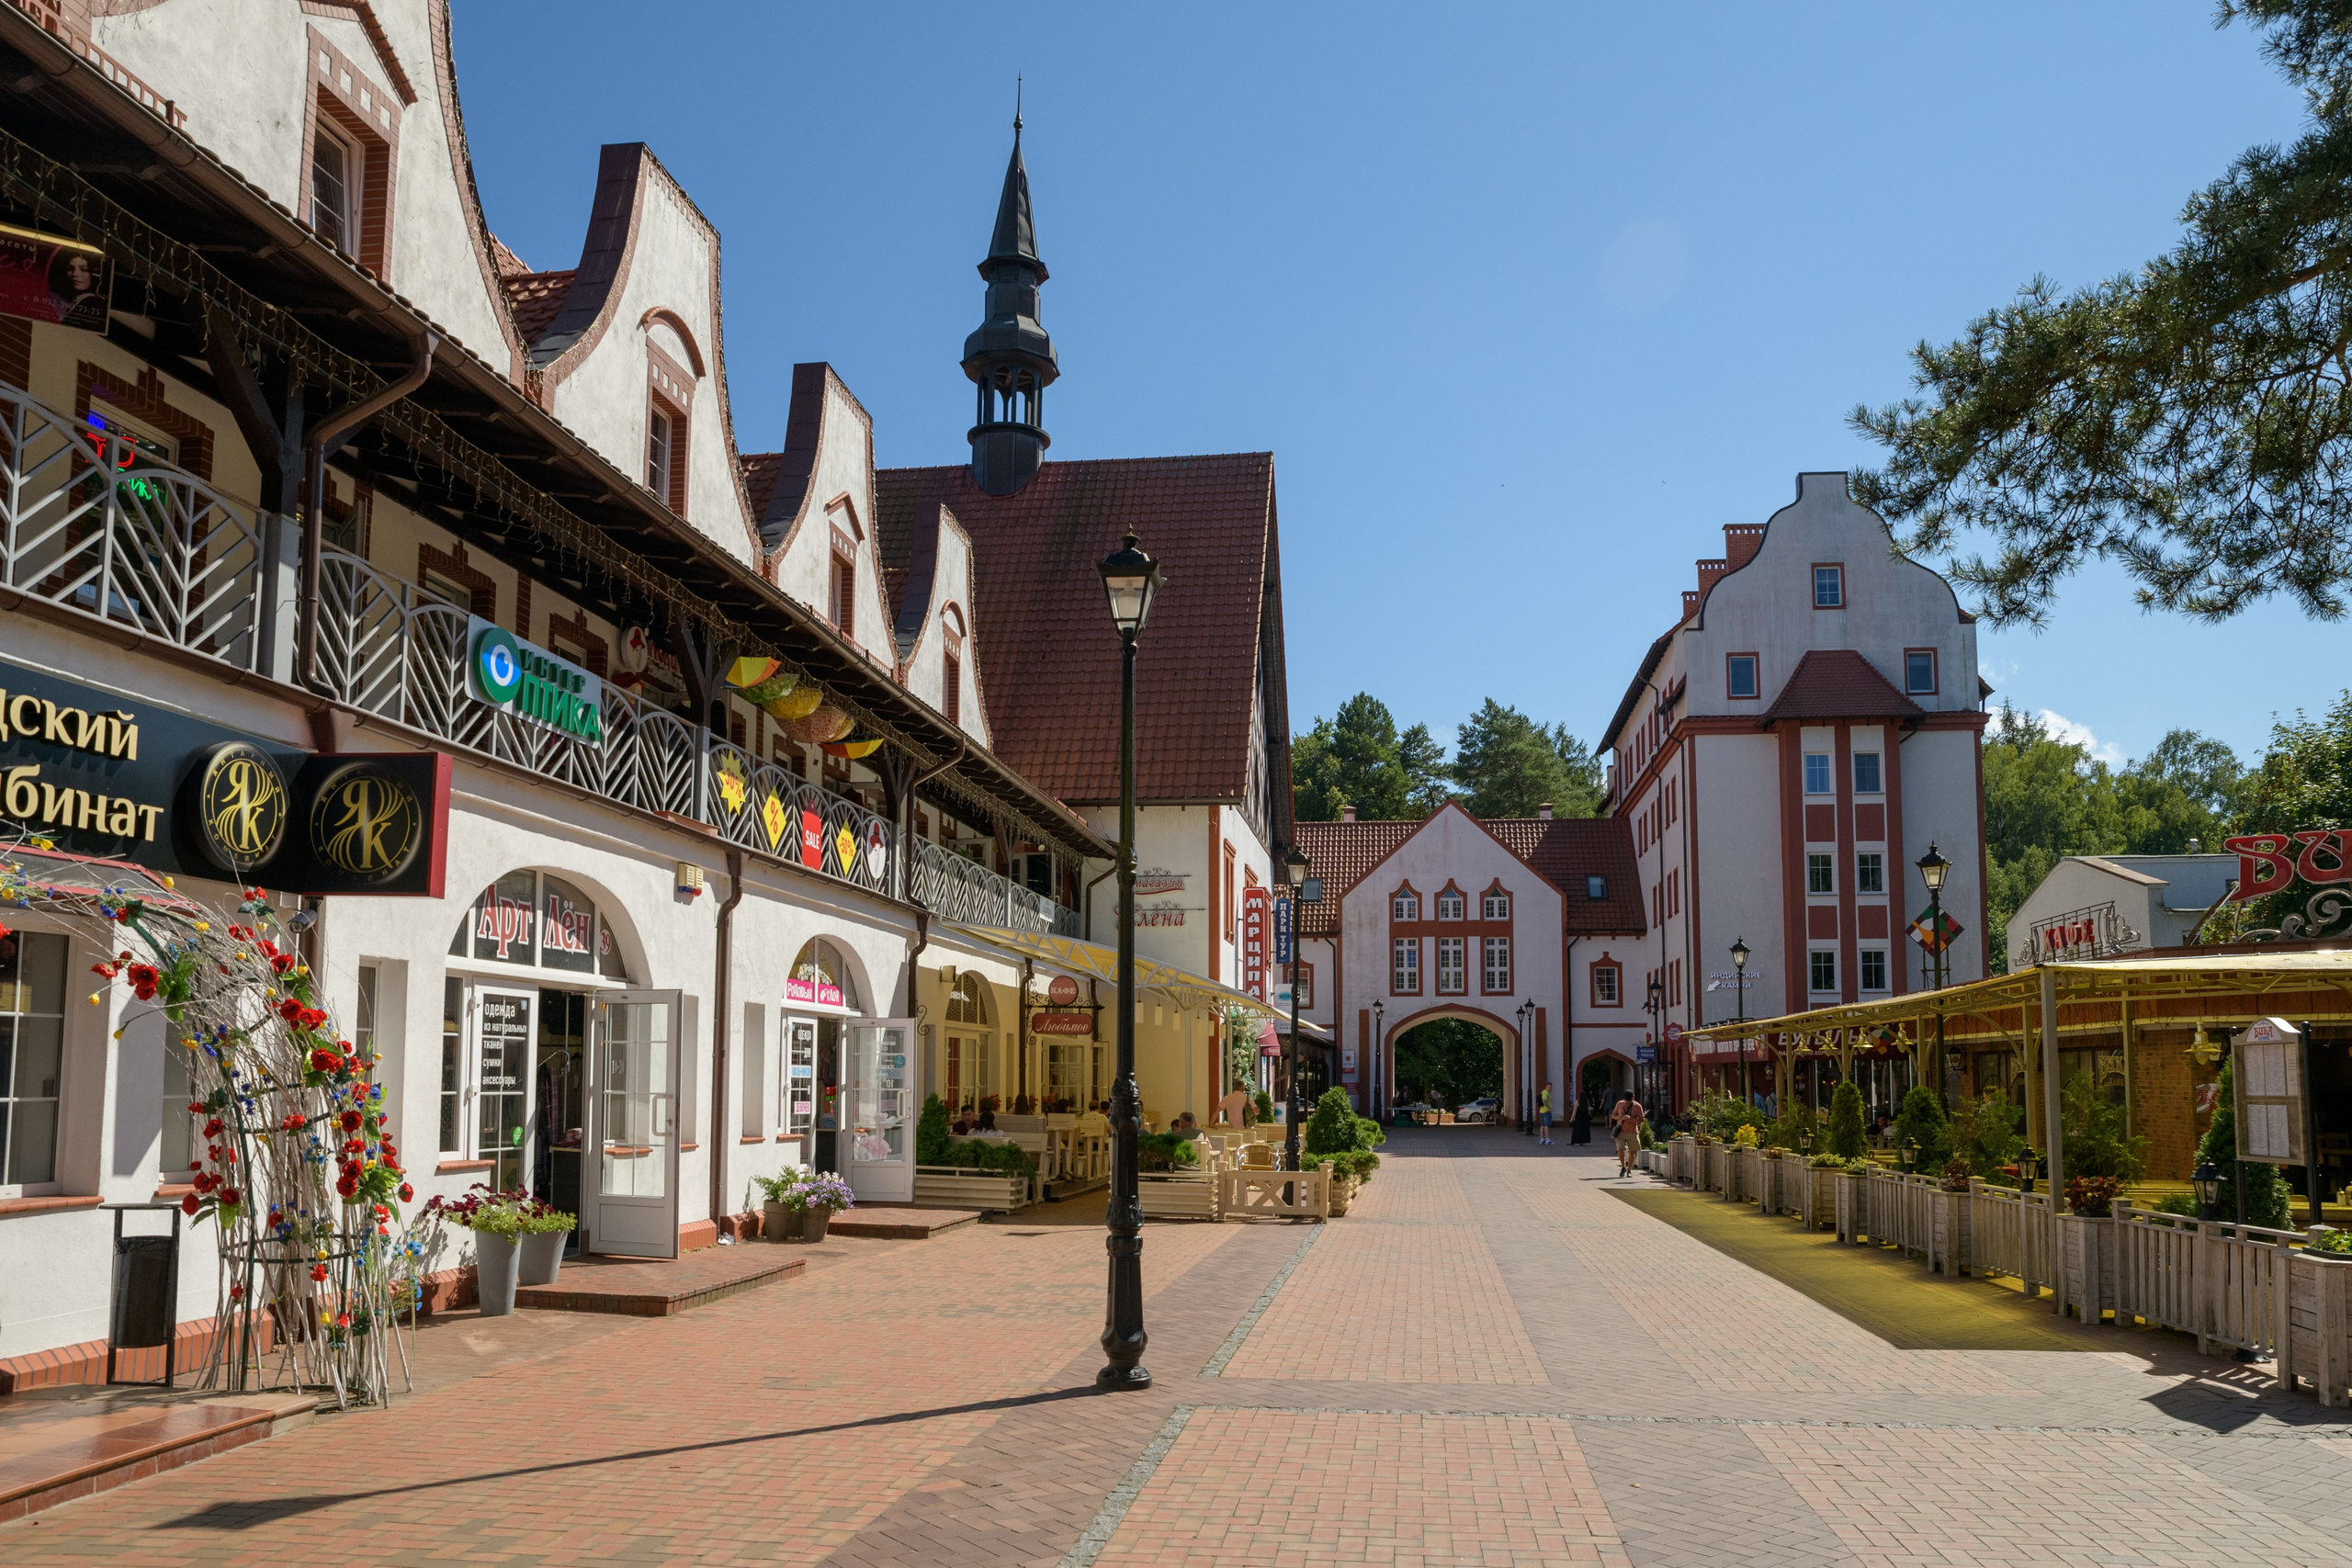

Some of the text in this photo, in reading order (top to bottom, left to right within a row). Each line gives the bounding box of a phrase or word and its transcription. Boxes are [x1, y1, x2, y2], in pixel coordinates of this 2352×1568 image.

[520, 649, 586, 694] ИНТЕР
[722, 767, 741, 799] -30%
[0, 763, 164, 841] бинат
[805, 829, 820, 851] SALE
[839, 837, 854, 858] -50%
[477, 884, 611, 959] Арт Лён 39
[2043, 919, 2096, 952] КАФЕ
[1246, 897, 1263, 998] МАРЦИПА
[1050, 987, 1076, 995] КАФЕ
[484, 1003, 515, 1020] одежда
[483, 1022, 491, 1032] из
[1036, 1017, 1089, 1032] Любимое
[482, 1038, 504, 1050] тканей
[482, 1057, 502, 1069] сумки
